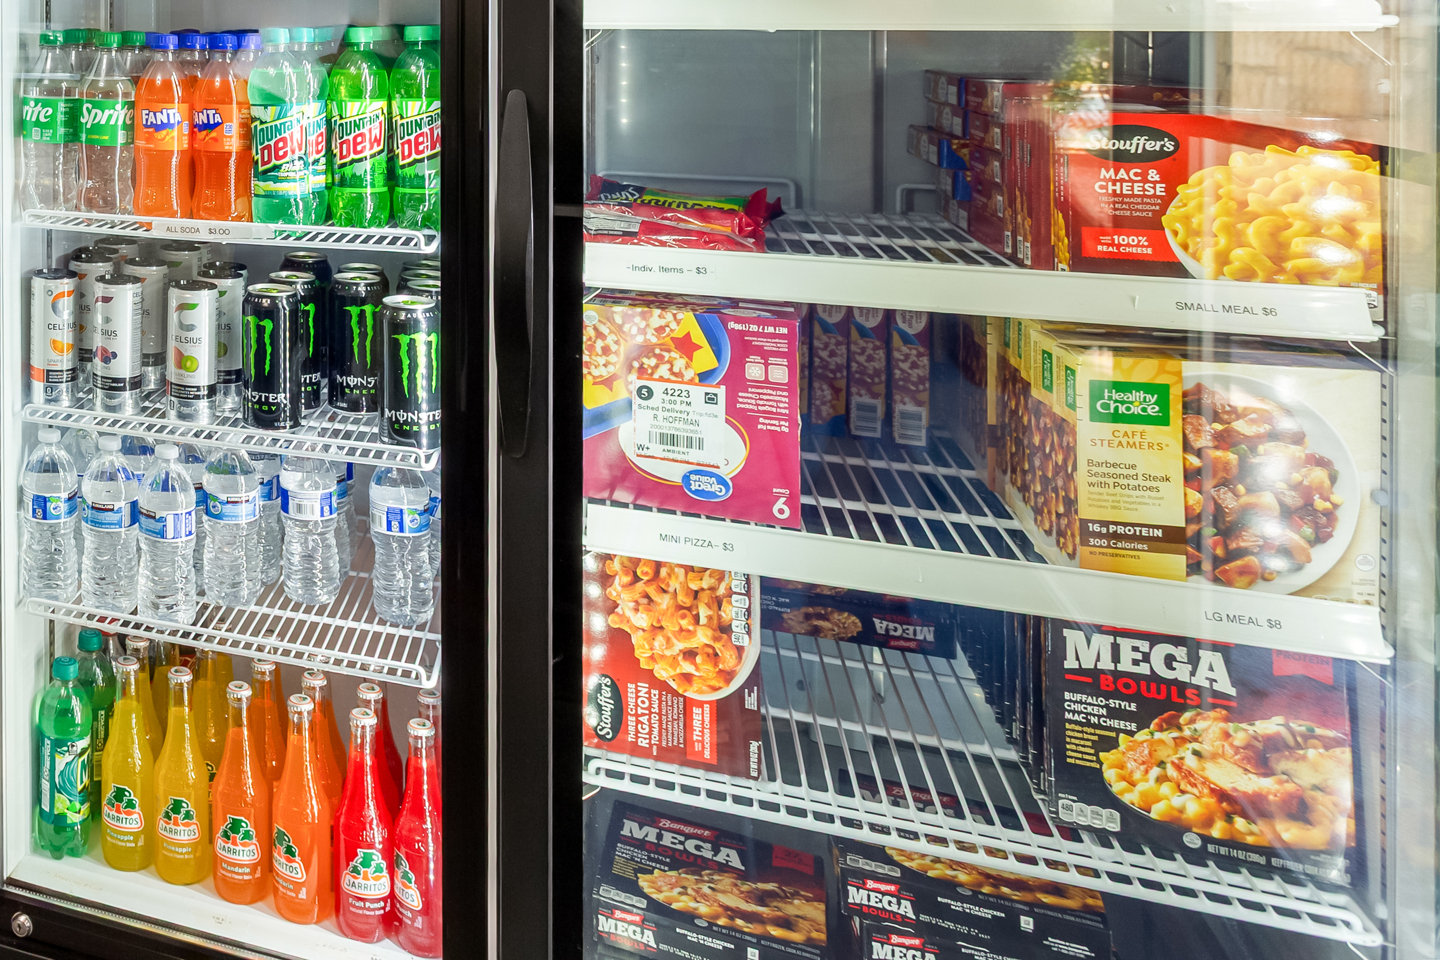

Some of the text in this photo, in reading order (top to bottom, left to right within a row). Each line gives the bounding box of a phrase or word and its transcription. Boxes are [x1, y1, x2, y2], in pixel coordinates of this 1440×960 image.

[23, 100, 53, 122] rite
[80, 103, 134, 128] Sprite
[141, 108, 182, 126] FANTA
[1088, 134, 1175, 154] Stouffer's
[1099, 167, 1161, 181] MAC &
[1094, 181, 1166, 196] CHEESE
[165, 225, 231, 236] ALL SODA $3.00
[1112, 234, 1149, 246] 100%
[1120, 246, 1153, 254] CHEESE
[659, 264, 684, 275] Items
[695, 265, 708, 276] $3
[1175, 300, 1278, 318] SMALL MEAL $6
[728, 321, 788, 334] NET WT OZ (198g)
[641, 388, 649, 398] 5
[662, 387, 691, 399] 4223
[738, 392, 758, 400] Cheese
[1103, 388, 1158, 405] Healthy
[637, 403, 660, 412] Sched
[662, 406, 690, 416] Delivery
[661, 398, 677, 406] 3:00
[736, 403, 758, 412] Topped
[758, 399, 778, 407] Tomato
[1096, 399, 1162, 416] Choice
[662, 415, 700, 427] HOFFMAN
[759, 417, 778, 426] Serving
[1111, 429, 1148, 440] CAFÉ
[636, 443, 650, 452] W+
[662, 448, 690, 456] AMBIENT
[1090, 438, 1164, 452] STEAMERS
[1087, 458, 1137, 471] Barbecue
[689, 473, 718, 484] Value
[1087, 469, 1172, 483] Seasoned Steak
[690, 481, 726, 496] Great
[772, 487, 790, 496] Count
[1087, 480, 1160, 493] with Potatoes
[1087, 523, 1163, 538] 16g PROTEIN
[659, 533, 681, 545] MINI
[722, 540, 735, 552] $3
[1088, 538, 1148, 551] 300 Calories
[1098, 551, 1141, 560] PRESERVATIVES
[1204, 610, 1283, 630] LG MEAL $8
[872, 617, 936, 642] MEGA
[1062, 628, 1237, 697] MEGA
[1099, 674, 1202, 707] BOWLS
[595, 675, 614, 739] Stouffer's
[1064, 691, 1137, 711] BUFFALO-STYLE
[627, 683, 636, 742] THREE CHEESE
[637, 682, 650, 748] RIGATONI
[1064, 702, 1107, 716] CHICKEN
[650, 689, 659, 745] TOMATO SAUCE
[692, 706, 702, 741] THREE
[1064, 711, 1086, 722] MAC
[1100, 717, 1138, 732] CHEESE
[104, 810, 139, 826] JARRITOS
[159, 824, 197, 838] JARRITOS
[658, 818, 712, 838] Banquet
[217, 843, 257, 859] JARRITOS
[620, 818, 746, 871] MEGA
[1207, 843, 1219, 854] NET
[1219, 846, 1229, 855] WT
[1237, 850, 1246, 859] OZ
[616, 843, 671, 863] BUFFALO-STYLE
[616, 847, 648, 860] CHICKEN
[644, 843, 719, 869] BOWLS
[221, 862, 251, 874] Mandarin
[615, 851, 669, 871] MAC CHEESE
[345, 877, 388, 892] JARRITOS
[865, 879, 896, 892] Banquet
[348, 897, 385, 909] Fruit Punch
[847, 886, 917, 920] MEGA
[937, 896, 1006, 918] BUFFALO-STYLE CHICKEN
[862, 906, 903, 922] BOWLS
[597, 914, 657, 949] MEGA
[609, 933, 646, 951] BOWLS
